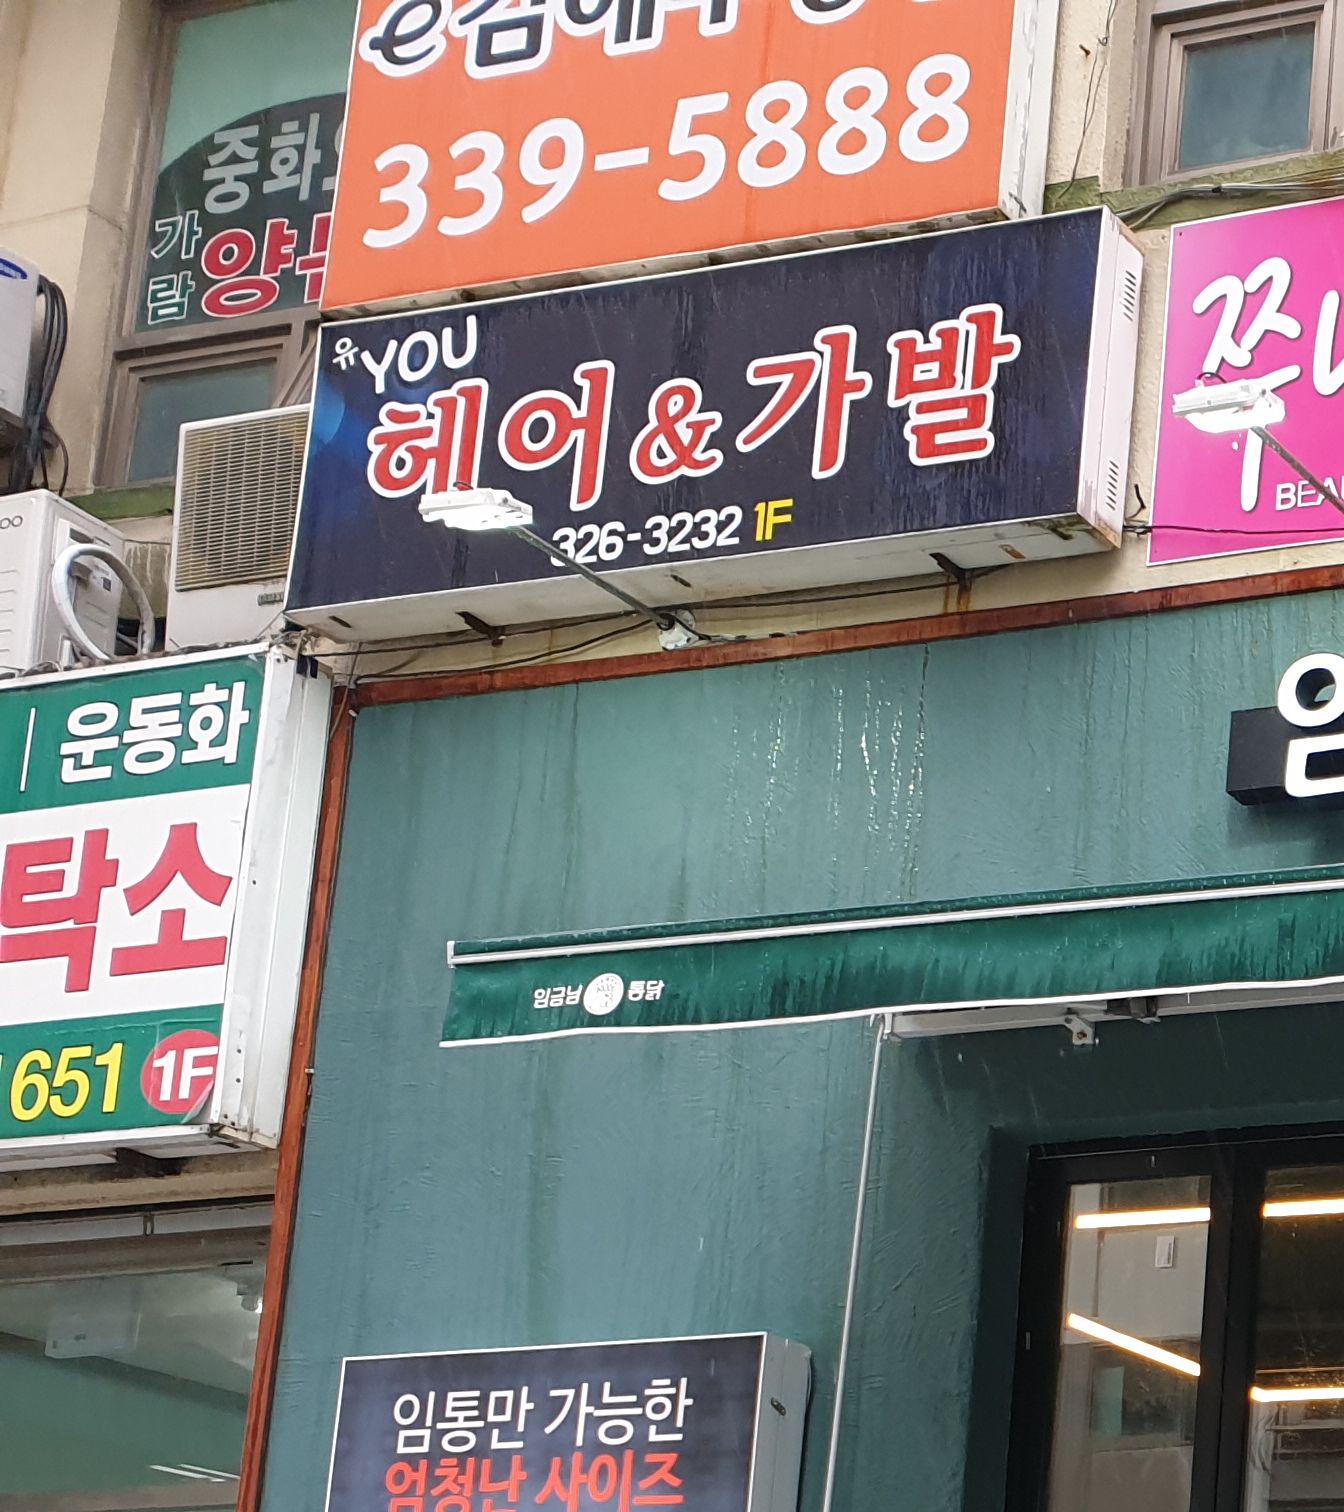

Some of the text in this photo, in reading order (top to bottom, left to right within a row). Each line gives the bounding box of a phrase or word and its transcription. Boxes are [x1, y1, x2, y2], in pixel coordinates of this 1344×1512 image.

[203, 113, 341, 214] 중화
[362, 53, 971, 248] 339-5888
[332, 315, 478, 393] 유 YOU
[550, 498, 794, 567] 326-3232 1F
[59, 680, 250, 784] 운동화
[533, 979, 664, 1009] 임금님 통닭
[152, 1045, 218, 1101] 1F
[393, 1377, 694, 1454] 임통만 가능한
